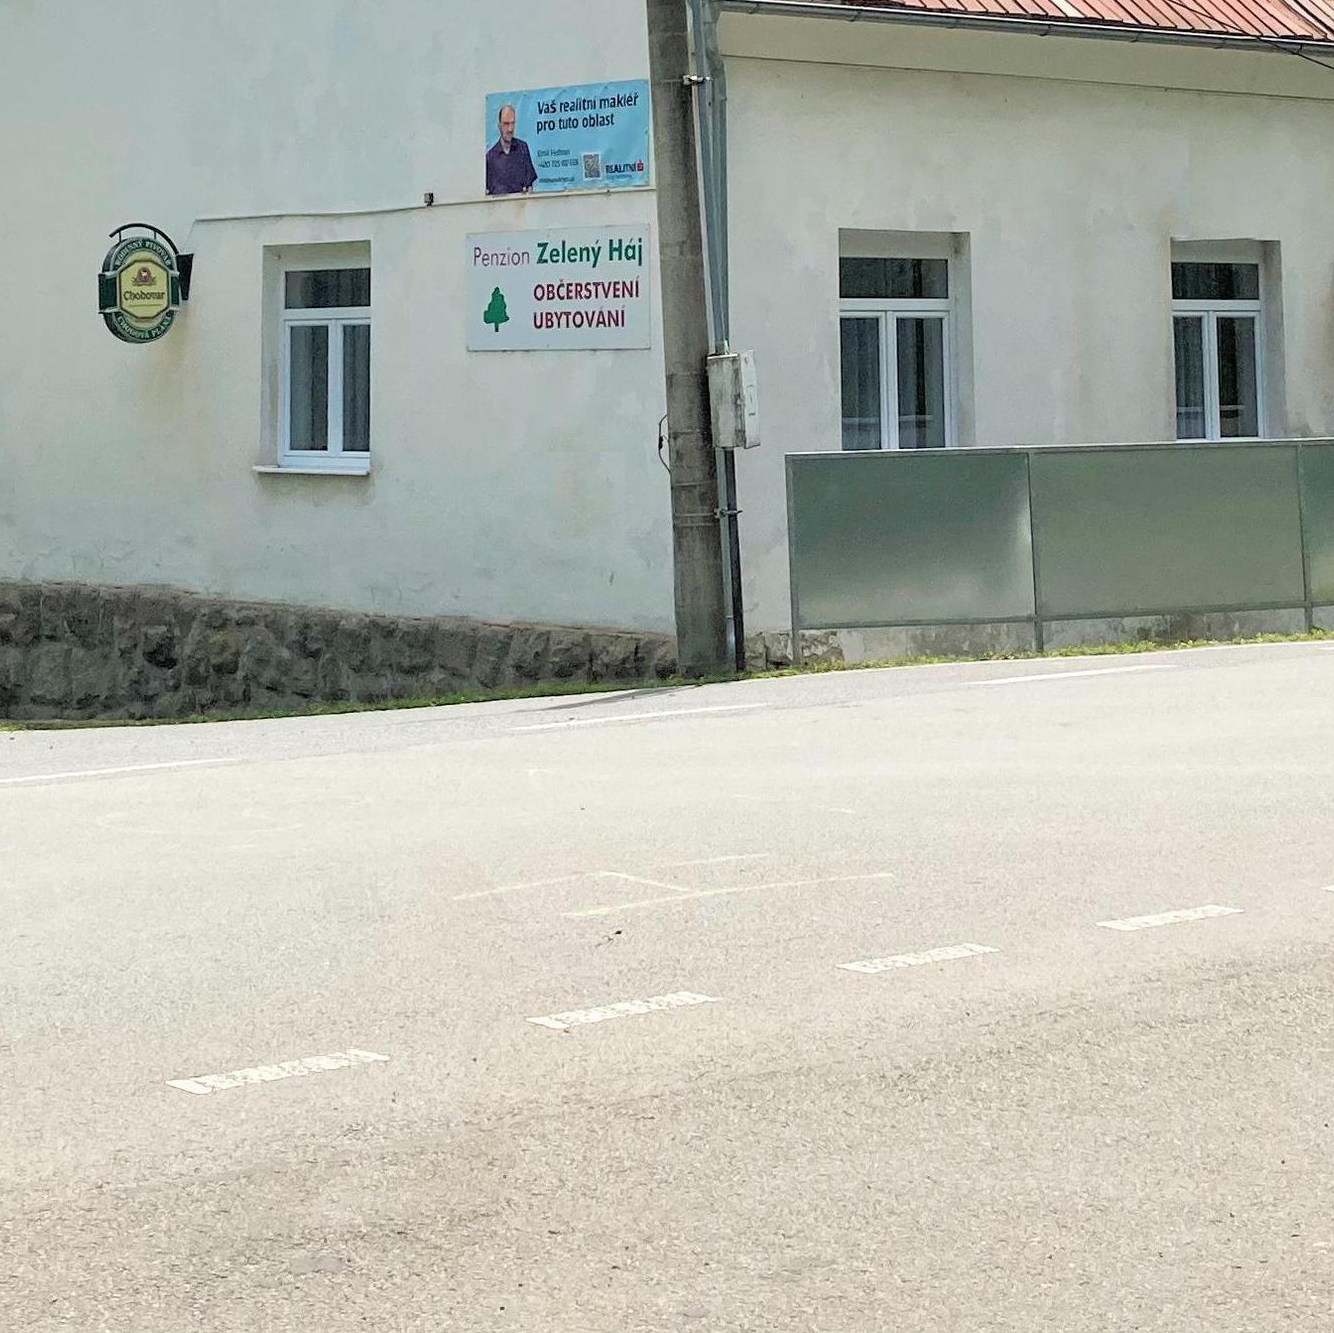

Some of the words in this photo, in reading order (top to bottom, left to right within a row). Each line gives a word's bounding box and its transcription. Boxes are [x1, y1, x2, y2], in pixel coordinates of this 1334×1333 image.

[536, 119, 555, 134] pro
[558, 116, 579, 130] tuto
[582, 113, 615, 128] oblast
[473, 246, 530, 266] Penzion
[536, 239, 602, 268] Zelený
[608, 237, 643, 266] Háj
[533, 275, 640, 301] OBČERSTVENÍ
[533, 305, 625, 329] UBYTOVÁNÍ
